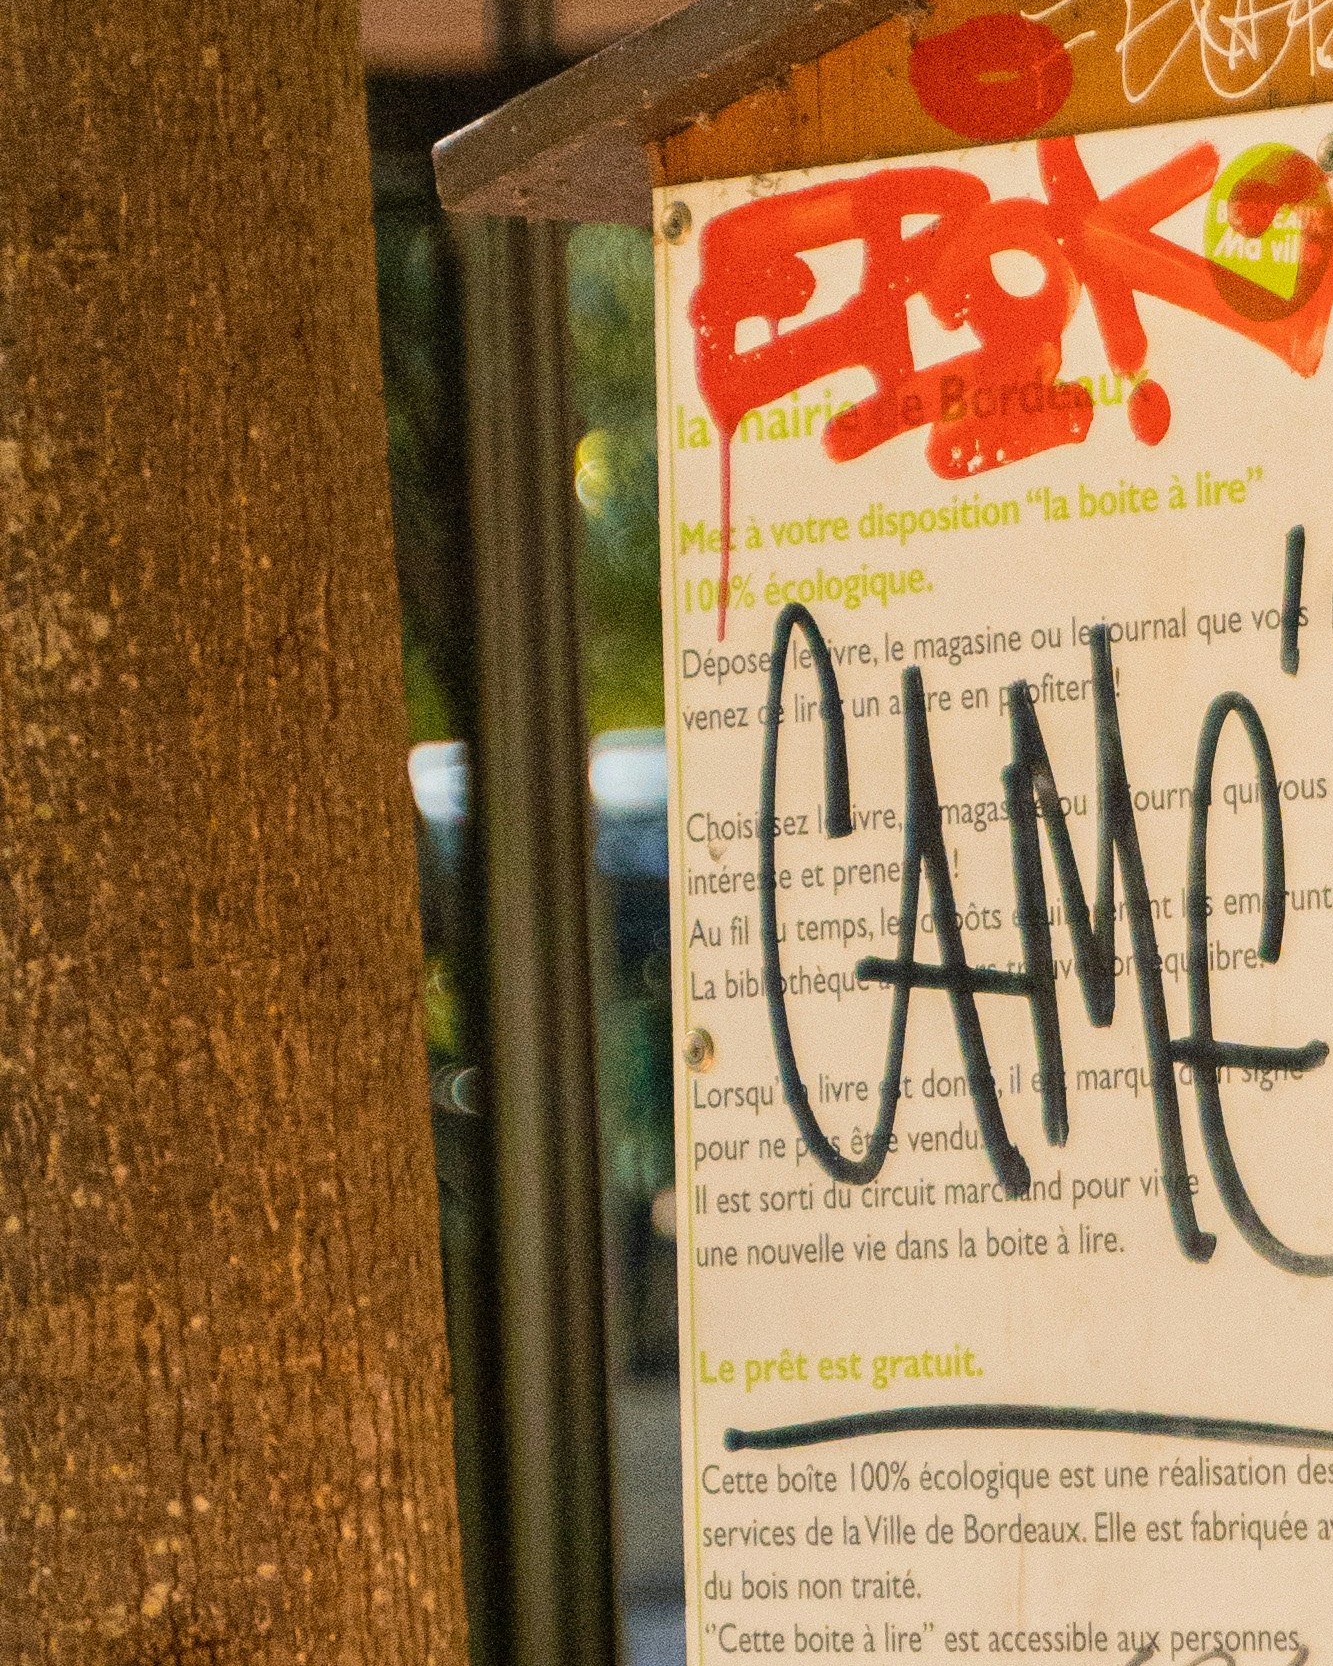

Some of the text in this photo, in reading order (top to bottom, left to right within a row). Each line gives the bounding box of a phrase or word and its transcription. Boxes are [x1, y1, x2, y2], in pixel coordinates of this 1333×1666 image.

[676, 404, 711, 450] la
[744, 514, 764, 551] à
[770, 516, 850, 548] votre
[857, 491, 1021, 547] disposition
[1078, 482, 1159, 520] boite
[1168, 474, 1188, 510] à
[764, 562, 935, 612] écologique.
[885, 631, 905, 663] le
[914, 625, 1022, 667] magasine
[1030, 627, 1062, 651] ou
[1197, 611, 1243, 647] que
[1251, 605, 1310, 632] vos
[683, 704, 749, 732] venez
[852, 696, 880, 719] un
[960, 686, 989, 711] en
[800, 862, 824, 888] et
[689, 919, 721, 948] Au
[730, 915, 750, 947] fil
[797, 915, 875, 949] temps,
[691, 971, 717, 1002] La
[819, 1072, 869, 1104] livre
[1009, 1064, 1021, 1095] il
[694, 1136, 750, 1171] pour
[758, 1135, 787, 1160] ne
[695, 1185, 708, 1216] Il
[716, 1189, 751, 1215] est
[759, 1182, 815, 1214] sorti
[824, 1180, 852, 1210] du
[861, 1177, 937, 1209] circuit
[1072, 1174, 1131, 1210] pour
[696, 1222, 1125, 1269] une nouvelle vie dans la boite à lire.
[700, 1343, 985, 1393] Le prêt est gratuit.
[702, 1463, 768, 1495] Cette
[777, 1462, 838, 1494] boîte
[849, 1459, 911, 1492] 100%
[919, 1459, 1050, 1499] écologique
[1059, 1464, 1096, 1489] est
[1104, 1464, 1150, 1488] une
[1158, 1456, 1287, 1488] réalisation
[702, 1519, 797, 1548] services
[805, 1516, 834, 1546] de
[843, 1515, 862, 1546] la
[864, 1513, 917, 1546] Ville
[925, 1513, 955, 1545] de
[964, 1512, 1088, 1545] Bordeaux.
[1094, 1510, 1137, 1544] Elle
[1145, 1517, 1182, 1543] est
[1191, 1509, 1309, 1551] fabriquée
[704, 1567, 923, 1601] du bois non traité.
[793, 1622, 855, 1653] boite
[863, 1622, 877, 1653] à
[944, 1628, 981, 1654] est
[988, 1621, 1108, 1654] accessible
[1118, 1629, 1161, 1653] aux
[1170, 1628, 1300, 1662] personnes
